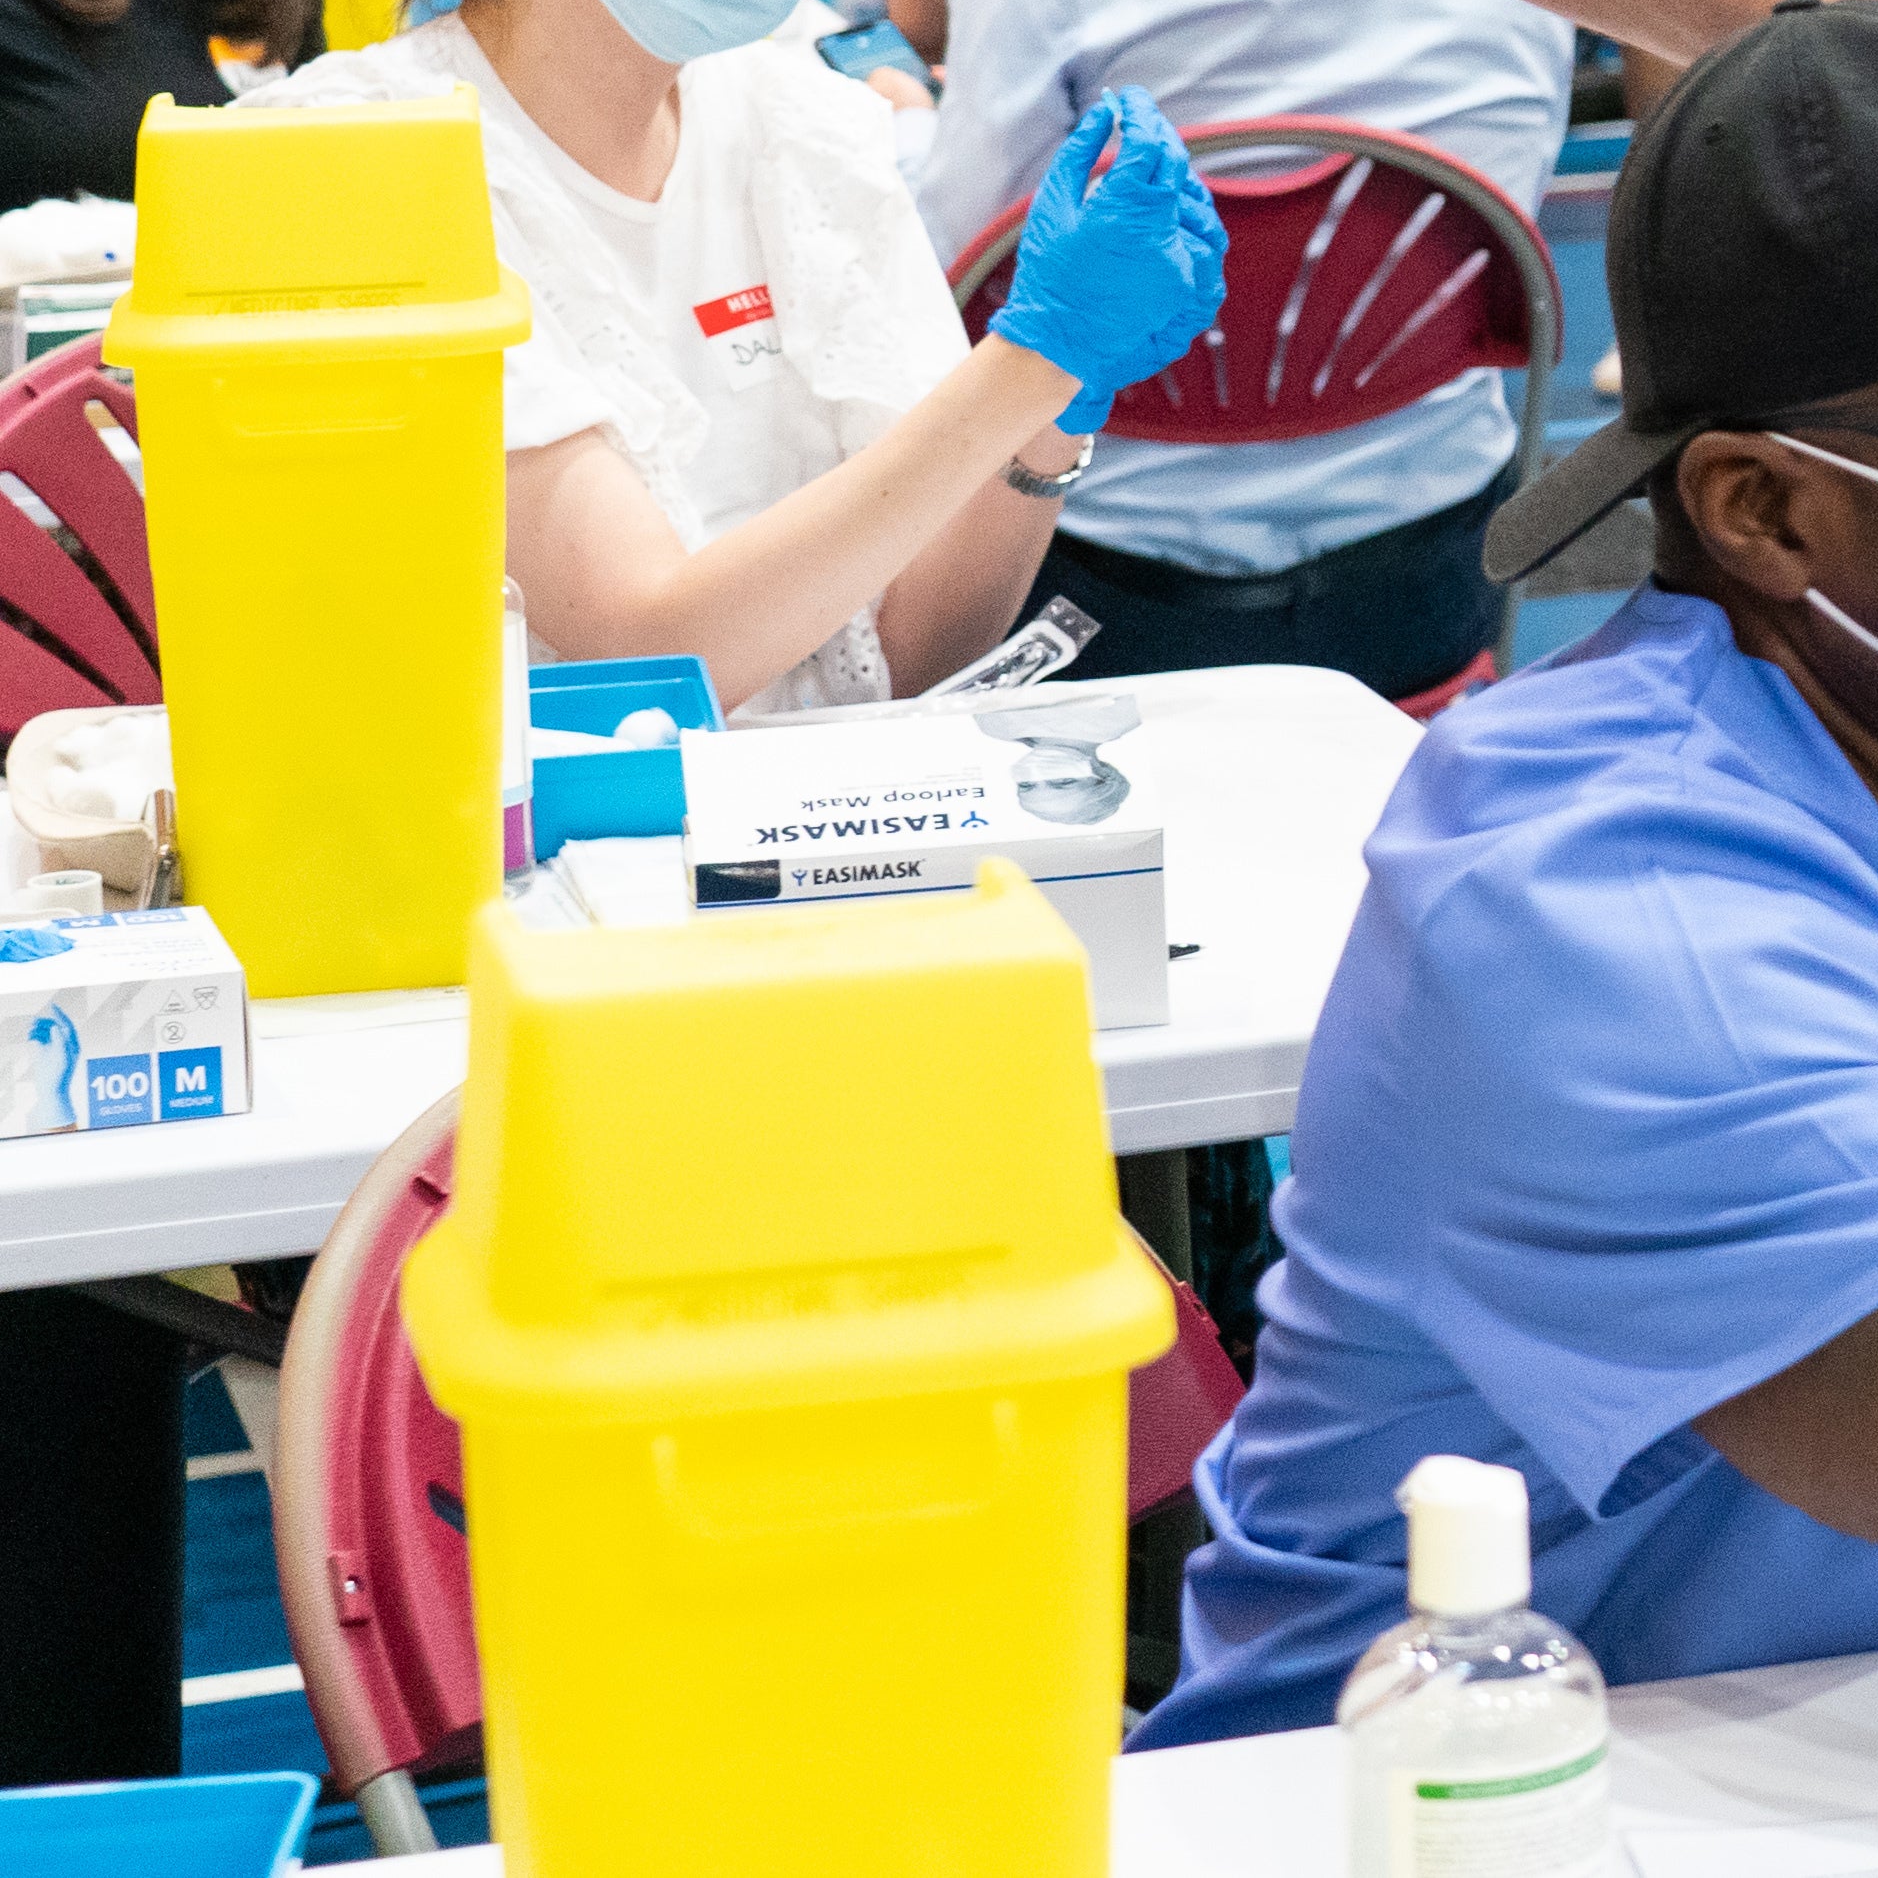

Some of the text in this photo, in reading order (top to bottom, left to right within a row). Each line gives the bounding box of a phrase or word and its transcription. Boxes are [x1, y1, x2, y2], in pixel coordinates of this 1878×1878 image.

[801, 786, 986, 813] Earloop Mask
[755, 812, 951, 845] EASIMASK
[813, 860, 922, 886] EASIMASK
[91, 1071, 150, 1101] 100
[175, 1065, 207, 1093] M
